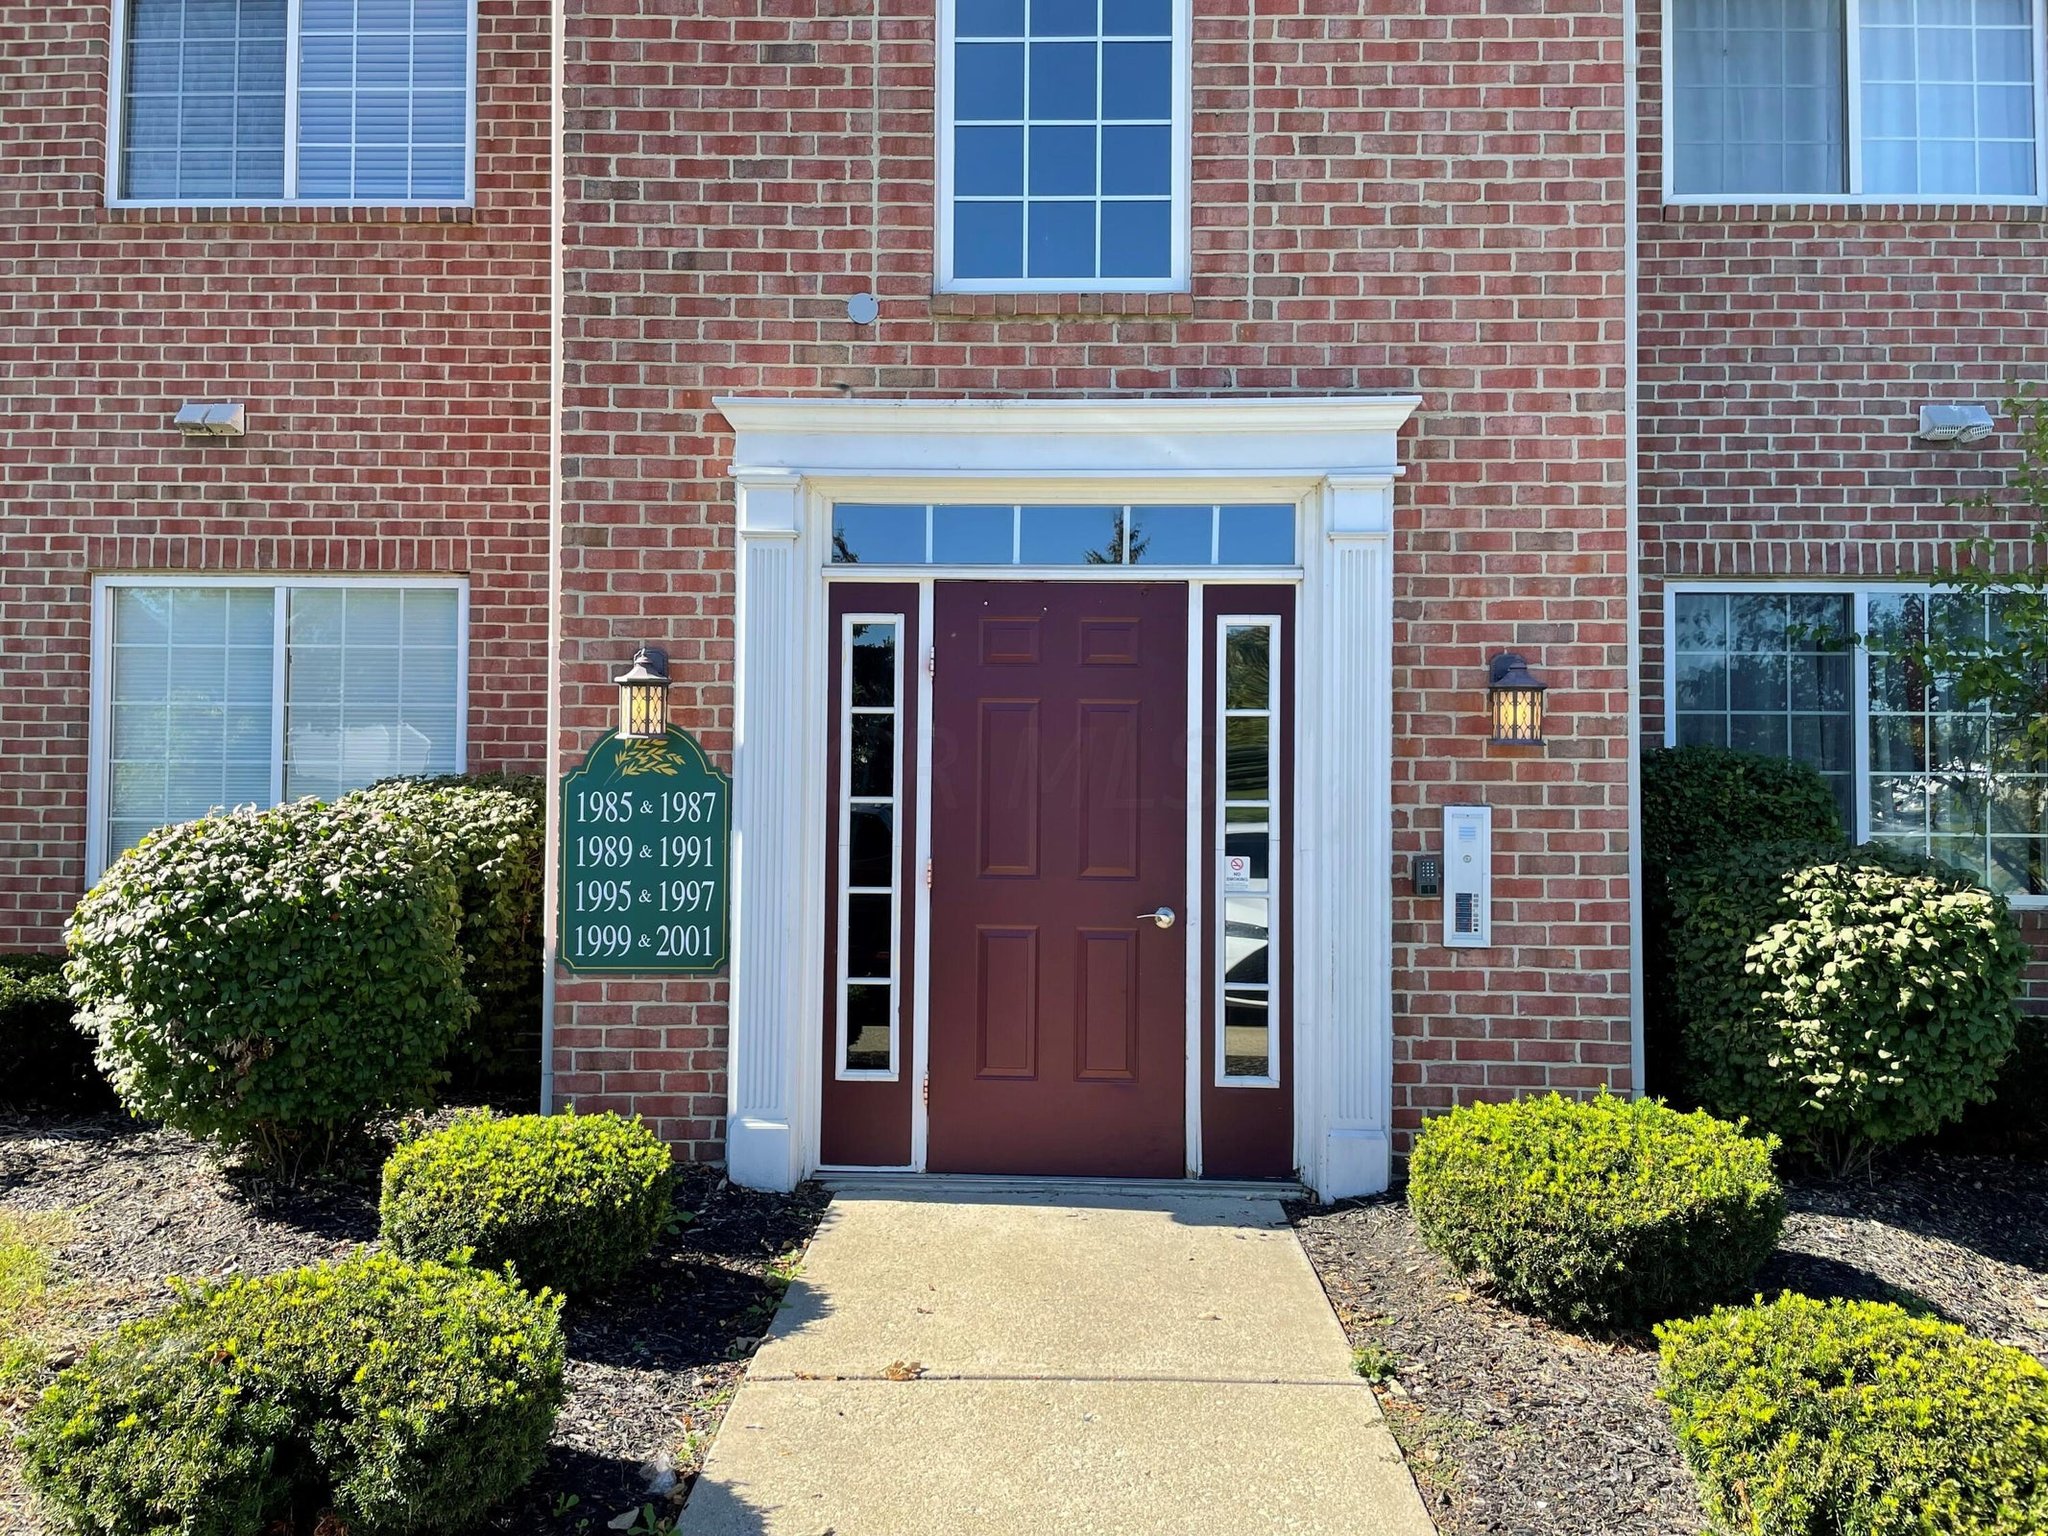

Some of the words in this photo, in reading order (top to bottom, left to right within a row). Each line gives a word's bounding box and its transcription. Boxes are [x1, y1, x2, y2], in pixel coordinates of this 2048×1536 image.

[578, 792, 633, 822] 1985
[640, 801, 654, 813] &
[661, 792, 716, 822] 1987
[577, 836, 633, 867] 1989
[640, 845, 653, 857] &
[660, 836, 714, 867] 1991
[577, 880, 632, 911] 1995
[639, 890, 652, 902] &
[660, 881, 715, 912] 1997
[576, 925, 632, 956] 1999
[638, 934, 652, 947] &
[656, 925, 712, 956] 2001
